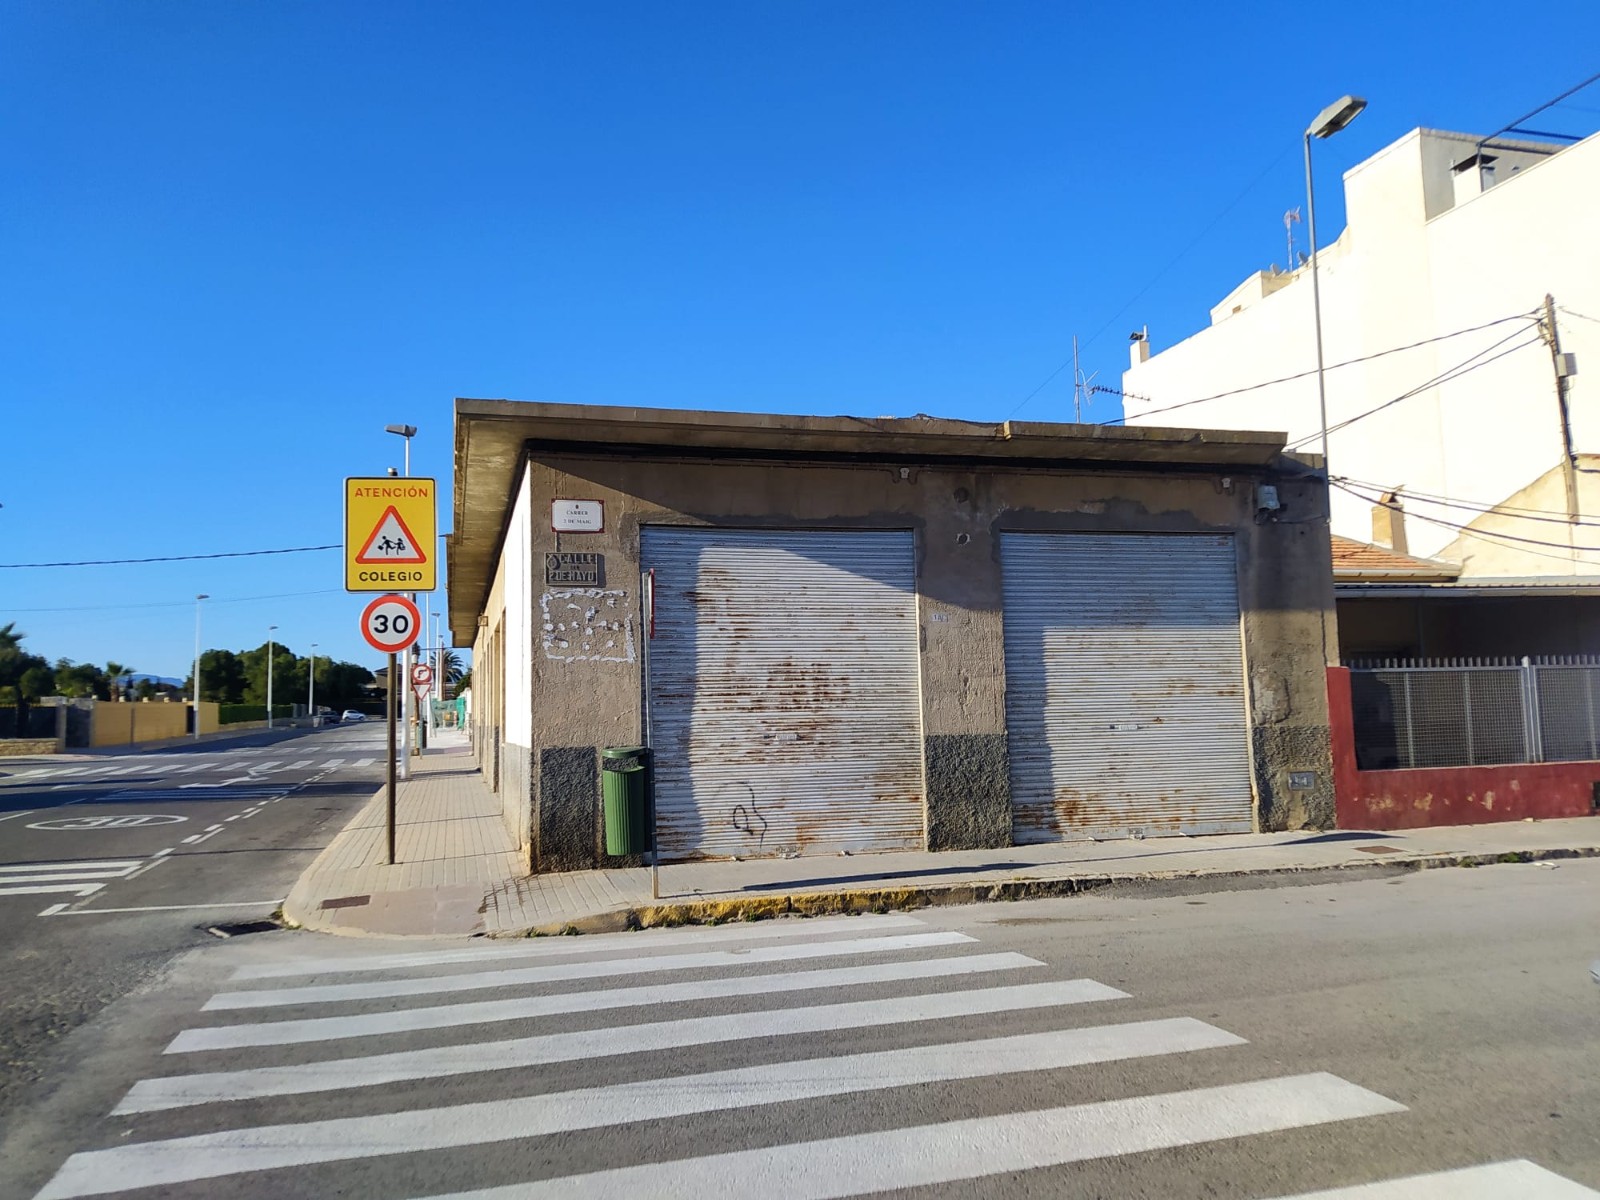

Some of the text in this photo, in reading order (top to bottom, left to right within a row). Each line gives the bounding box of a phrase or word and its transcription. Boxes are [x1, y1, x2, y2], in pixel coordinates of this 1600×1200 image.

[355, 486, 428, 498] ATENCIÓN
[560, 554, 594, 563] CALLE
[359, 571, 423, 582] COLEGIO
[373, 614, 409, 634] 30
[63, 815, 152, 828] 30
